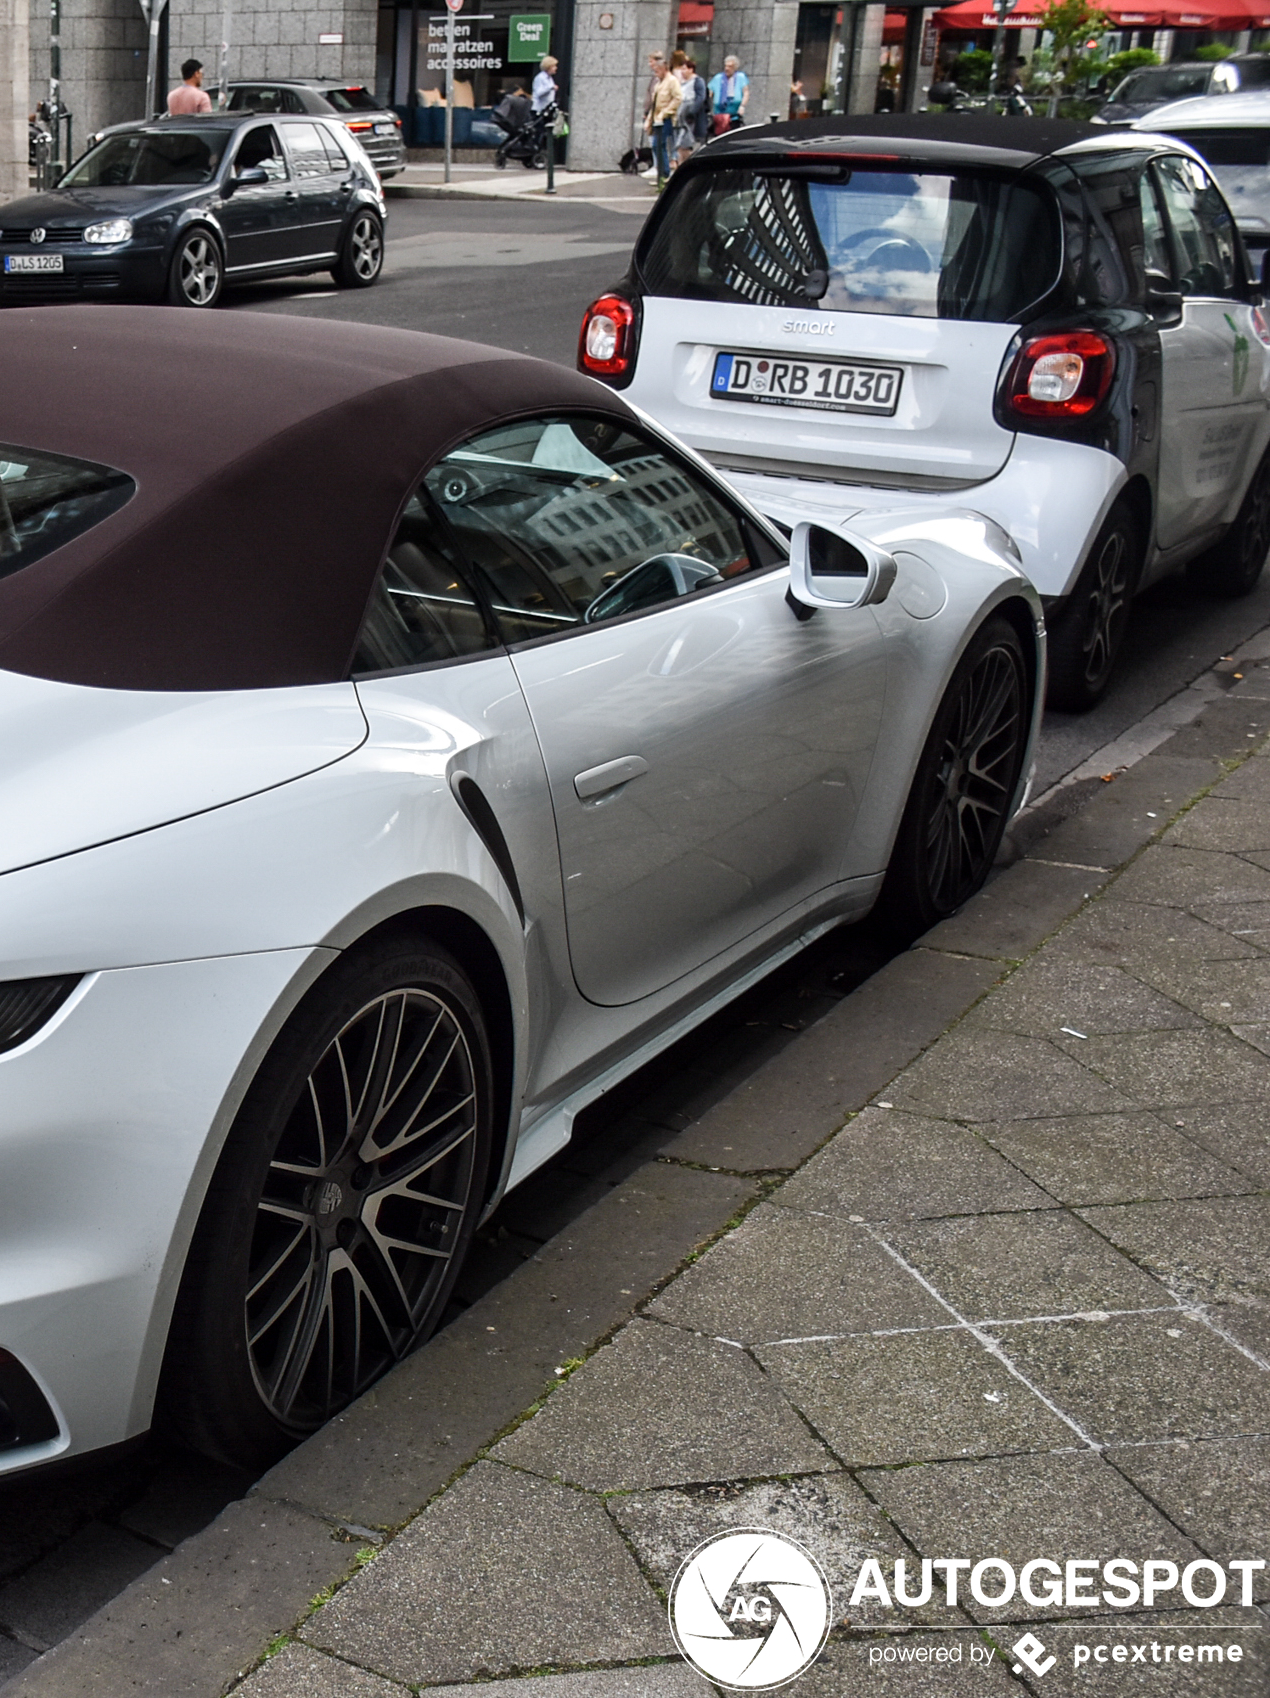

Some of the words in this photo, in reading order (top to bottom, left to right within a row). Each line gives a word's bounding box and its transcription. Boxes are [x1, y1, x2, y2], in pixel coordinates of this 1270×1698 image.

[428, 23, 470, 37] beten
[517, 22, 543, 32] Green
[520, 32, 540, 41] Deal
[427, 40, 493, 53] maratzen
[10, 257, 17, 270] D
[22, 257, 35, 270] LS
[37, 256, 62, 270] 1205
[782, 319, 836, 336] smart
[717, 376, 726, 386] D
[731, 360, 752, 389] D
[769, 363, 810, 395] RB
[814, 367, 894, 404] 1030
[760, 396, 846, 411] smart-duesseldorf.com
